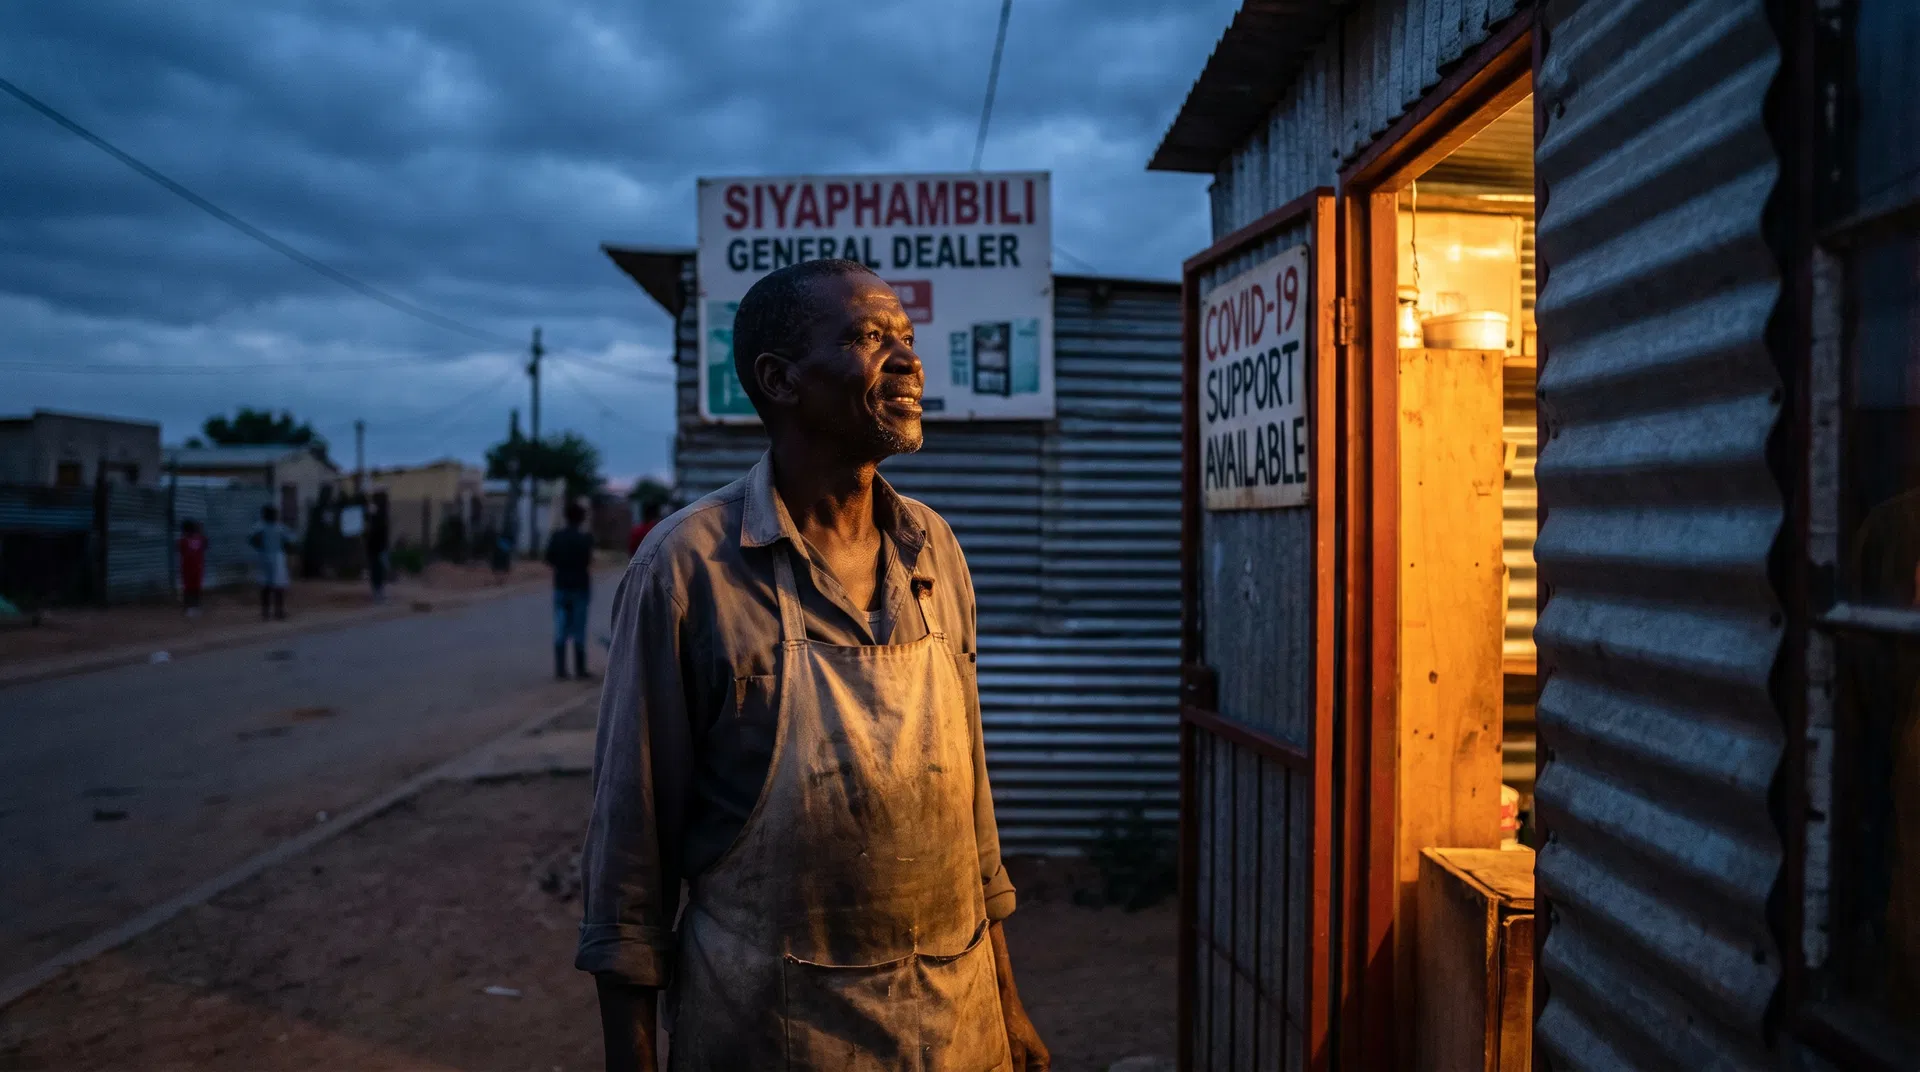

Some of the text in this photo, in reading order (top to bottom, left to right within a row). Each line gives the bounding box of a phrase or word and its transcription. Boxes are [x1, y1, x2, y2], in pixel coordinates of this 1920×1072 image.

[724, 180, 1036, 229] SIYAPHAMBILI
[727, 234, 1020, 270] GENERAL DEALER
[1206, 266, 1298, 361] COVID-19
[1206, 340, 1299, 424] SUPPORT
[1206, 417, 1307, 490] AVAILABLE
